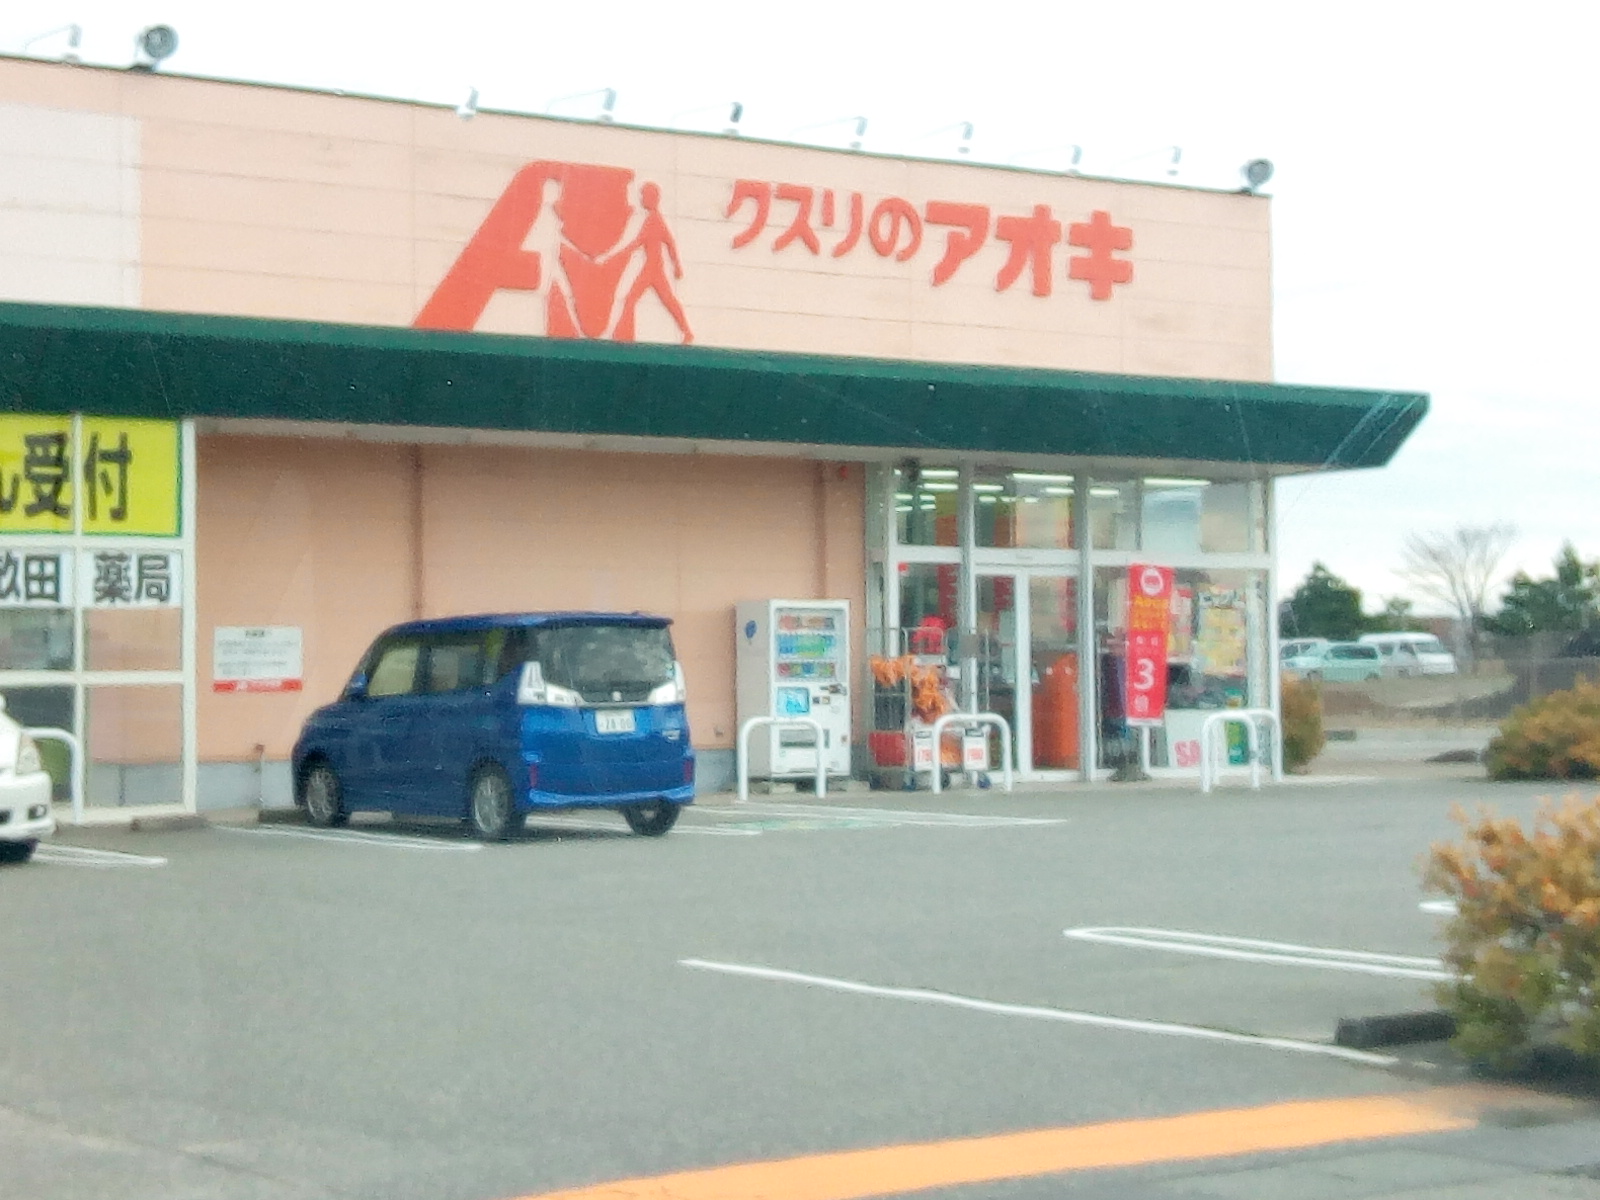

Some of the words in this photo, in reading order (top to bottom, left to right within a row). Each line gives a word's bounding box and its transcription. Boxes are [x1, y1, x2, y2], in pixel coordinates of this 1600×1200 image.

[724, 178, 1134, 302] クスリのアオキ
